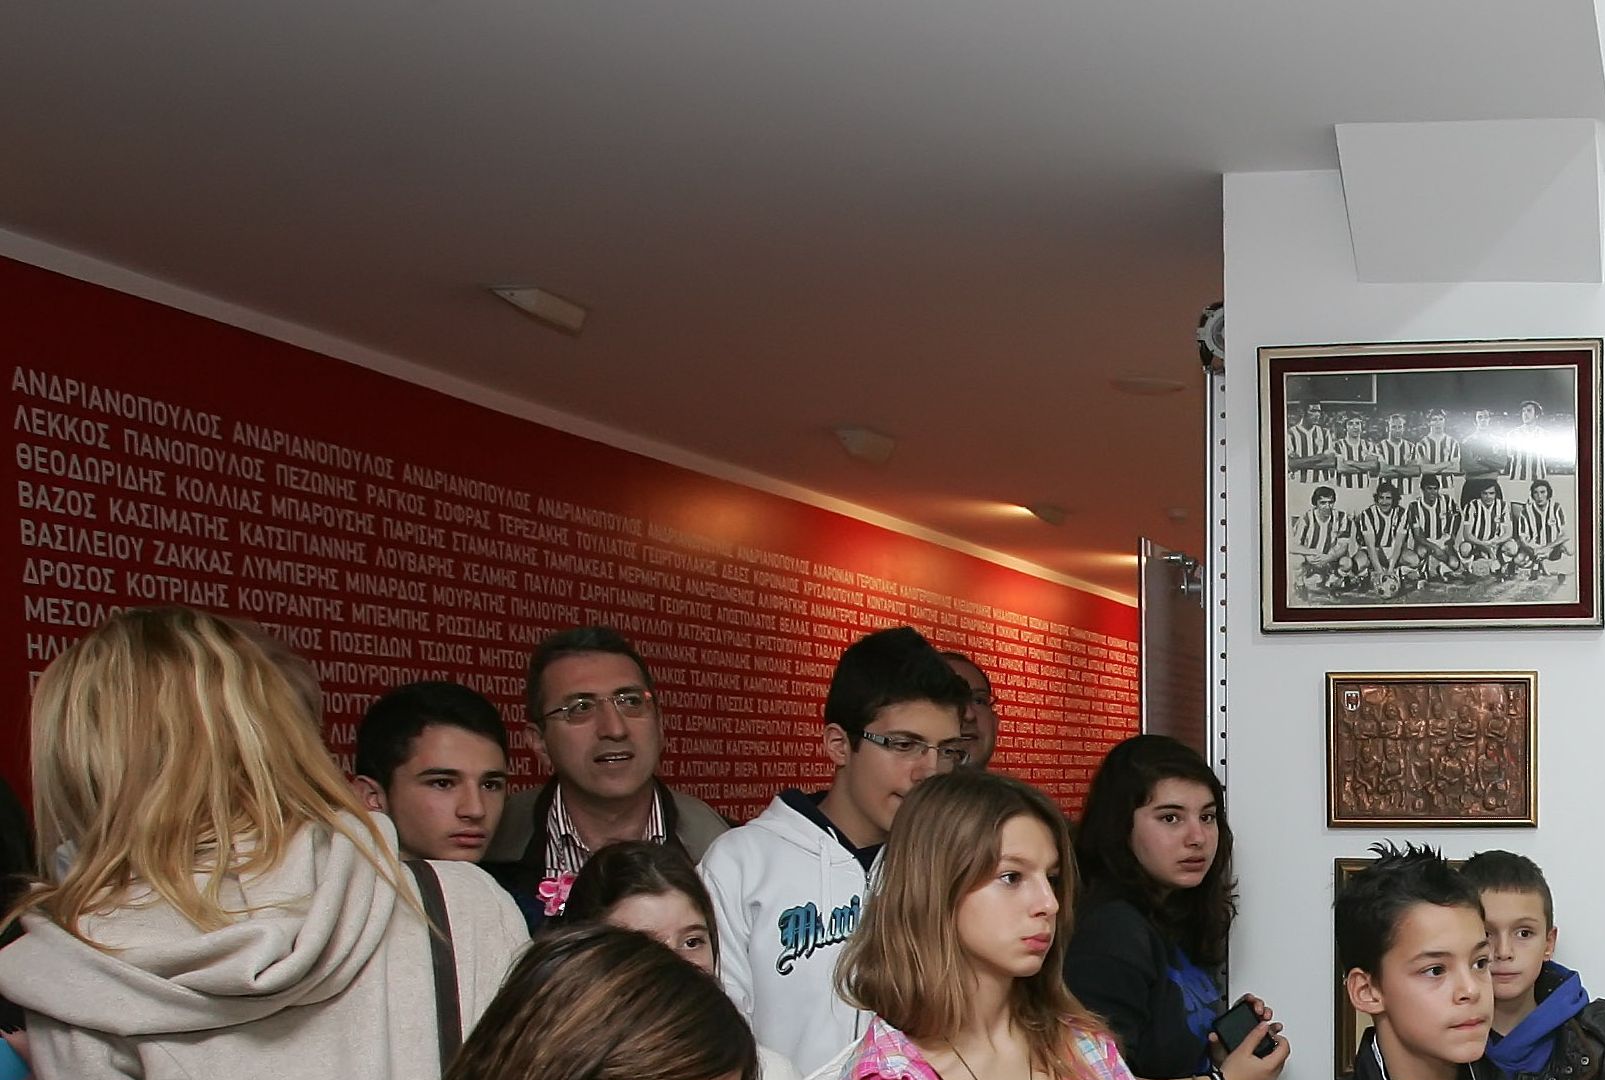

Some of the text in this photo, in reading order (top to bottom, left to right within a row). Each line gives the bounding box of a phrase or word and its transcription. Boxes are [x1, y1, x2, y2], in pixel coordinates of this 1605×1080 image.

[11, 365, 222, 441] ΑΝΔΡΙΑΝΟΠΟΥΛΟΣ
[231, 419, 394, 480] ΑΝΔΡΙΑΝΟΠΟΥΛΟΣ
[401, 461, 531, 511] ΑΝΔΡΙΑΝΟΠΟΥΛΟΣ
[12, 404, 110, 451] ΛΕΚΚΟΣ
[123, 428, 265, 483] ΠΑΝΟΠΟΥΛΟΣ
[275, 462, 357, 502] ΠΕΖΩΝΗΣ
[365, 482, 426, 516] ΡΑΓΚΟΣ
[434, 498, 490, 530] ΣΟΦΡΑΣ
[498, 512, 568, 546] ΤΕΡΕΖΑΚΗΣ
[15, 442, 166, 497] ΘΕΟΔΩΡΙΔΗΣ
[174, 474, 263, 515] ΚΟΛΛΙΑΣ
[271, 493, 375, 536] ΜΠΑΡΟΥΣΗΣ
[382, 516, 446, 549] ΠΑΡΙΣΗΣ
[452, 530, 537, 566] ΣΤΑΜΑΤΑΚΗΣ
[17, 480, 96, 520] ΒΑΖΟΣ
[108, 497, 229, 542] ΚΑΣΙΜΑΤΗΣ
[239, 520, 367, 564] ΚΑΤΣΙΓΙΑΝΝΗΣ
[375, 544, 455, 579] ΛΟΥΒΑΡΗΣ
[462, 560, 517, 589] ΧΕΛΜΗΣ
[523, 571, 574, 598] ΠΑΥΛΟΥ
[19, 519, 144, 563] ΒΑΣΙΛΕΙΟΥ
[152, 539, 234, 576] ΖΑΚΚΑΣ
[241, 553, 339, 590] ΛΥΜΠΕΡΗΣ
[345, 569, 427, 603] ΜΙΝΑΡΔΟΣ
[432, 583, 506, 614] ΜΟΥΡΑΤΗΣ
[510, 595, 580, 624] ΠΗΛΙΟΥΡΗΣ
[21, 557, 116, 595] ΔΡΟΣΟΣ
[126, 571, 229, 608] ΚΟΤΡΙΔΗΣ
[237, 586, 343, 622] ΚΟΥΡΑΝΤΗΣ
[351, 601, 430, 632] ΜΠΕΜΠΗΣ
[436, 612, 502, 640] ΡΩΣΣΙΔΗΣ
[329, 629, 412, 659] ΠΟΣΕΙΔΩΝ
[418, 639, 473, 665] ΤΣΩΧΟΣ
